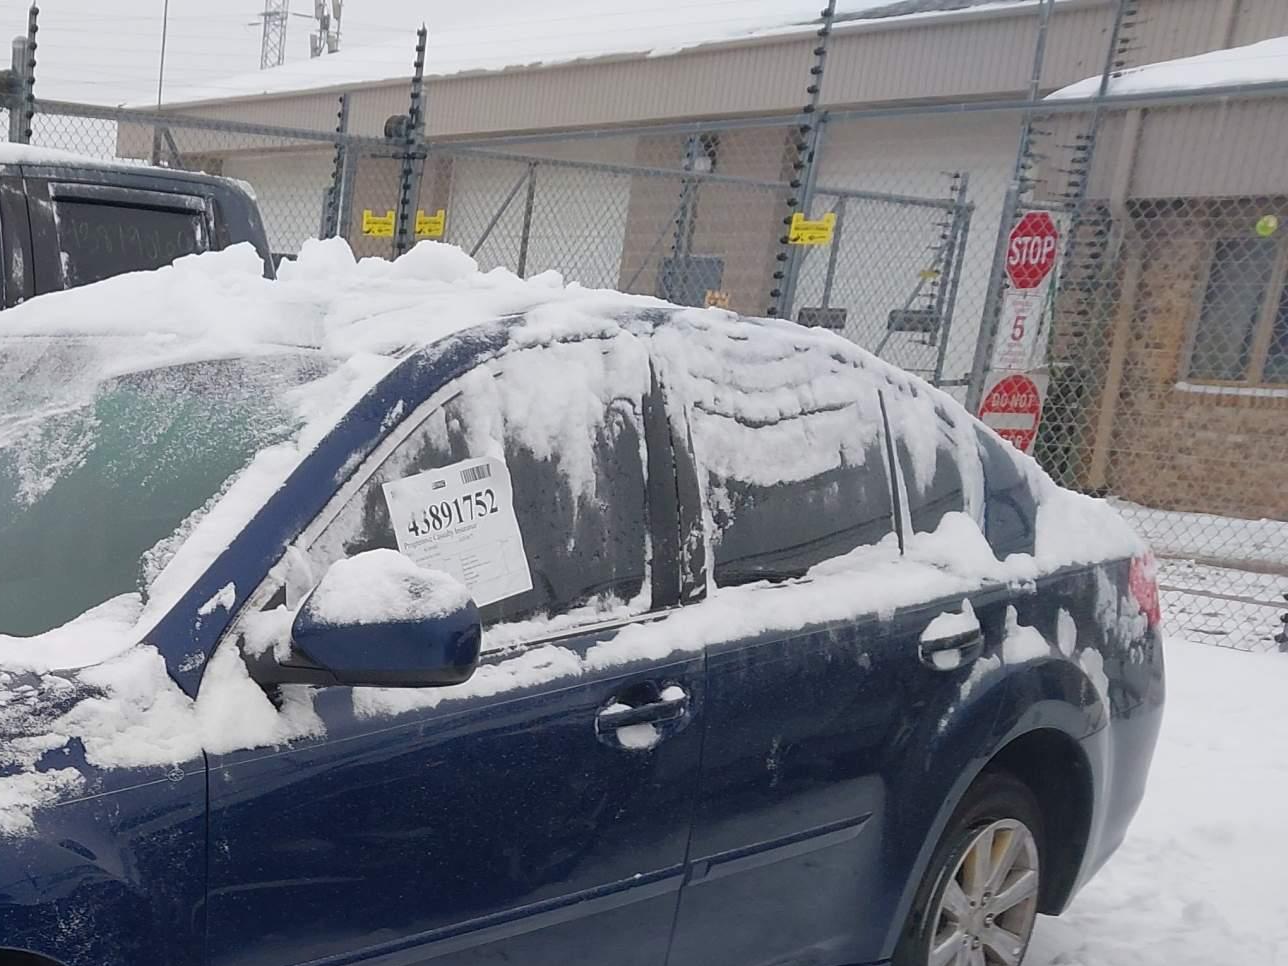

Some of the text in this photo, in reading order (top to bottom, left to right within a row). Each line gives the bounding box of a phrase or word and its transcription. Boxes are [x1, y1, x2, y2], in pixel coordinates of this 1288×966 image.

[1009, 235, 1055, 265] STOP
[1011, 315, 1027, 341] 5
[991, 392, 1037, 409] DO NOT
[407, 488, 499, 537] 43891752
